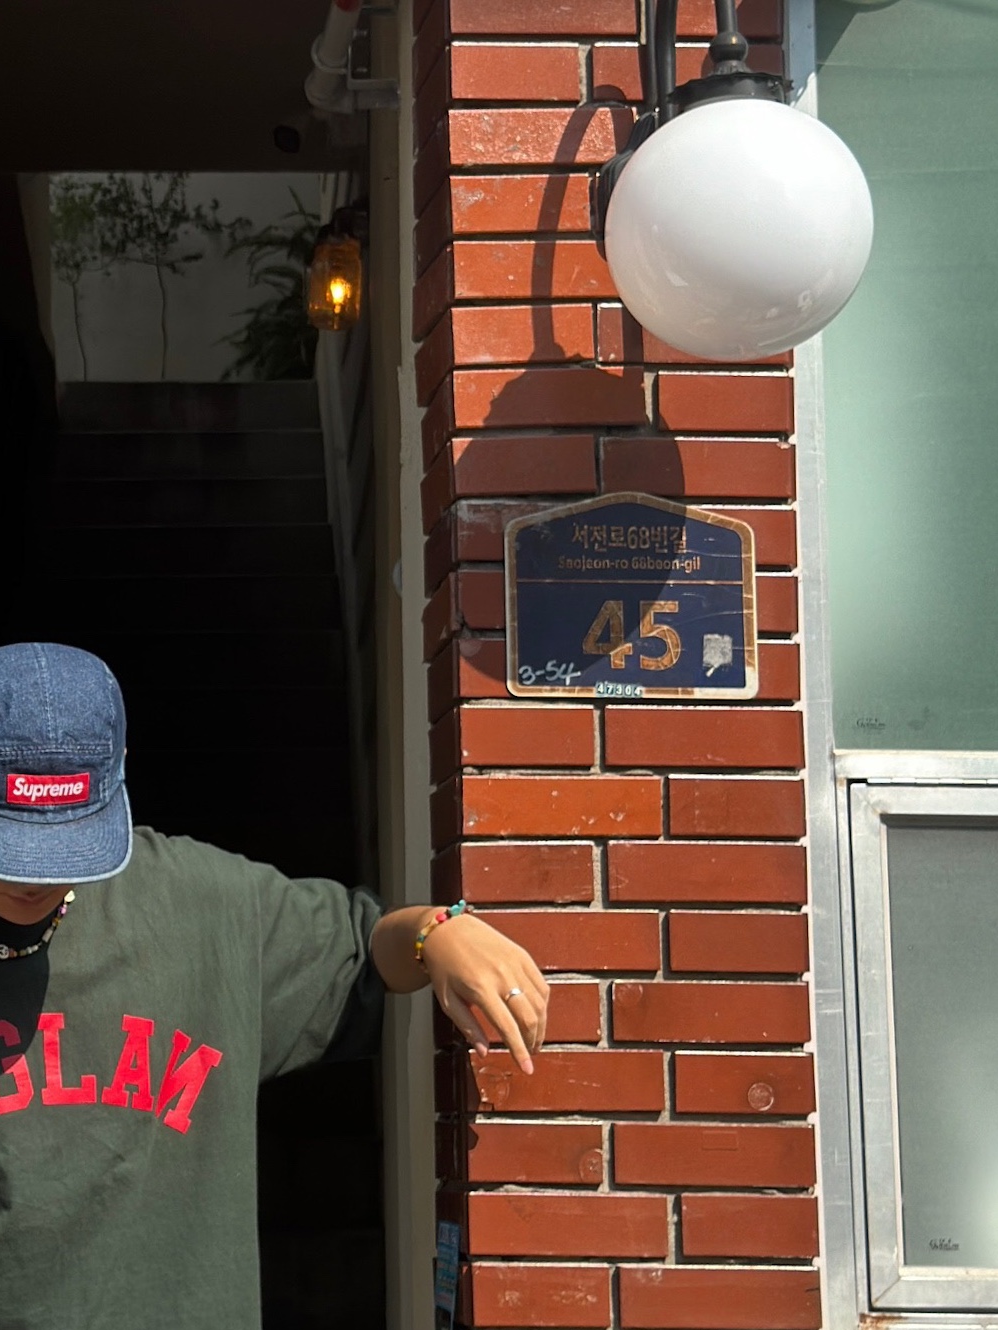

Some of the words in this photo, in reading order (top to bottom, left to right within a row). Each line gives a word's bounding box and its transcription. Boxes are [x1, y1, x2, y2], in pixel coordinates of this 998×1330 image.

[572, 524, 688, 554] 서전로68번길
[558, 555, 628, 572] Seojeon-ro
[631, 555, 701, 574] 68beon-gil
[582, 600, 682, 671] 45
[518, 660, 581, 686] 3-54
[596, 682, 643, 697] 47304
[12, 777, 84, 802] Supreme
